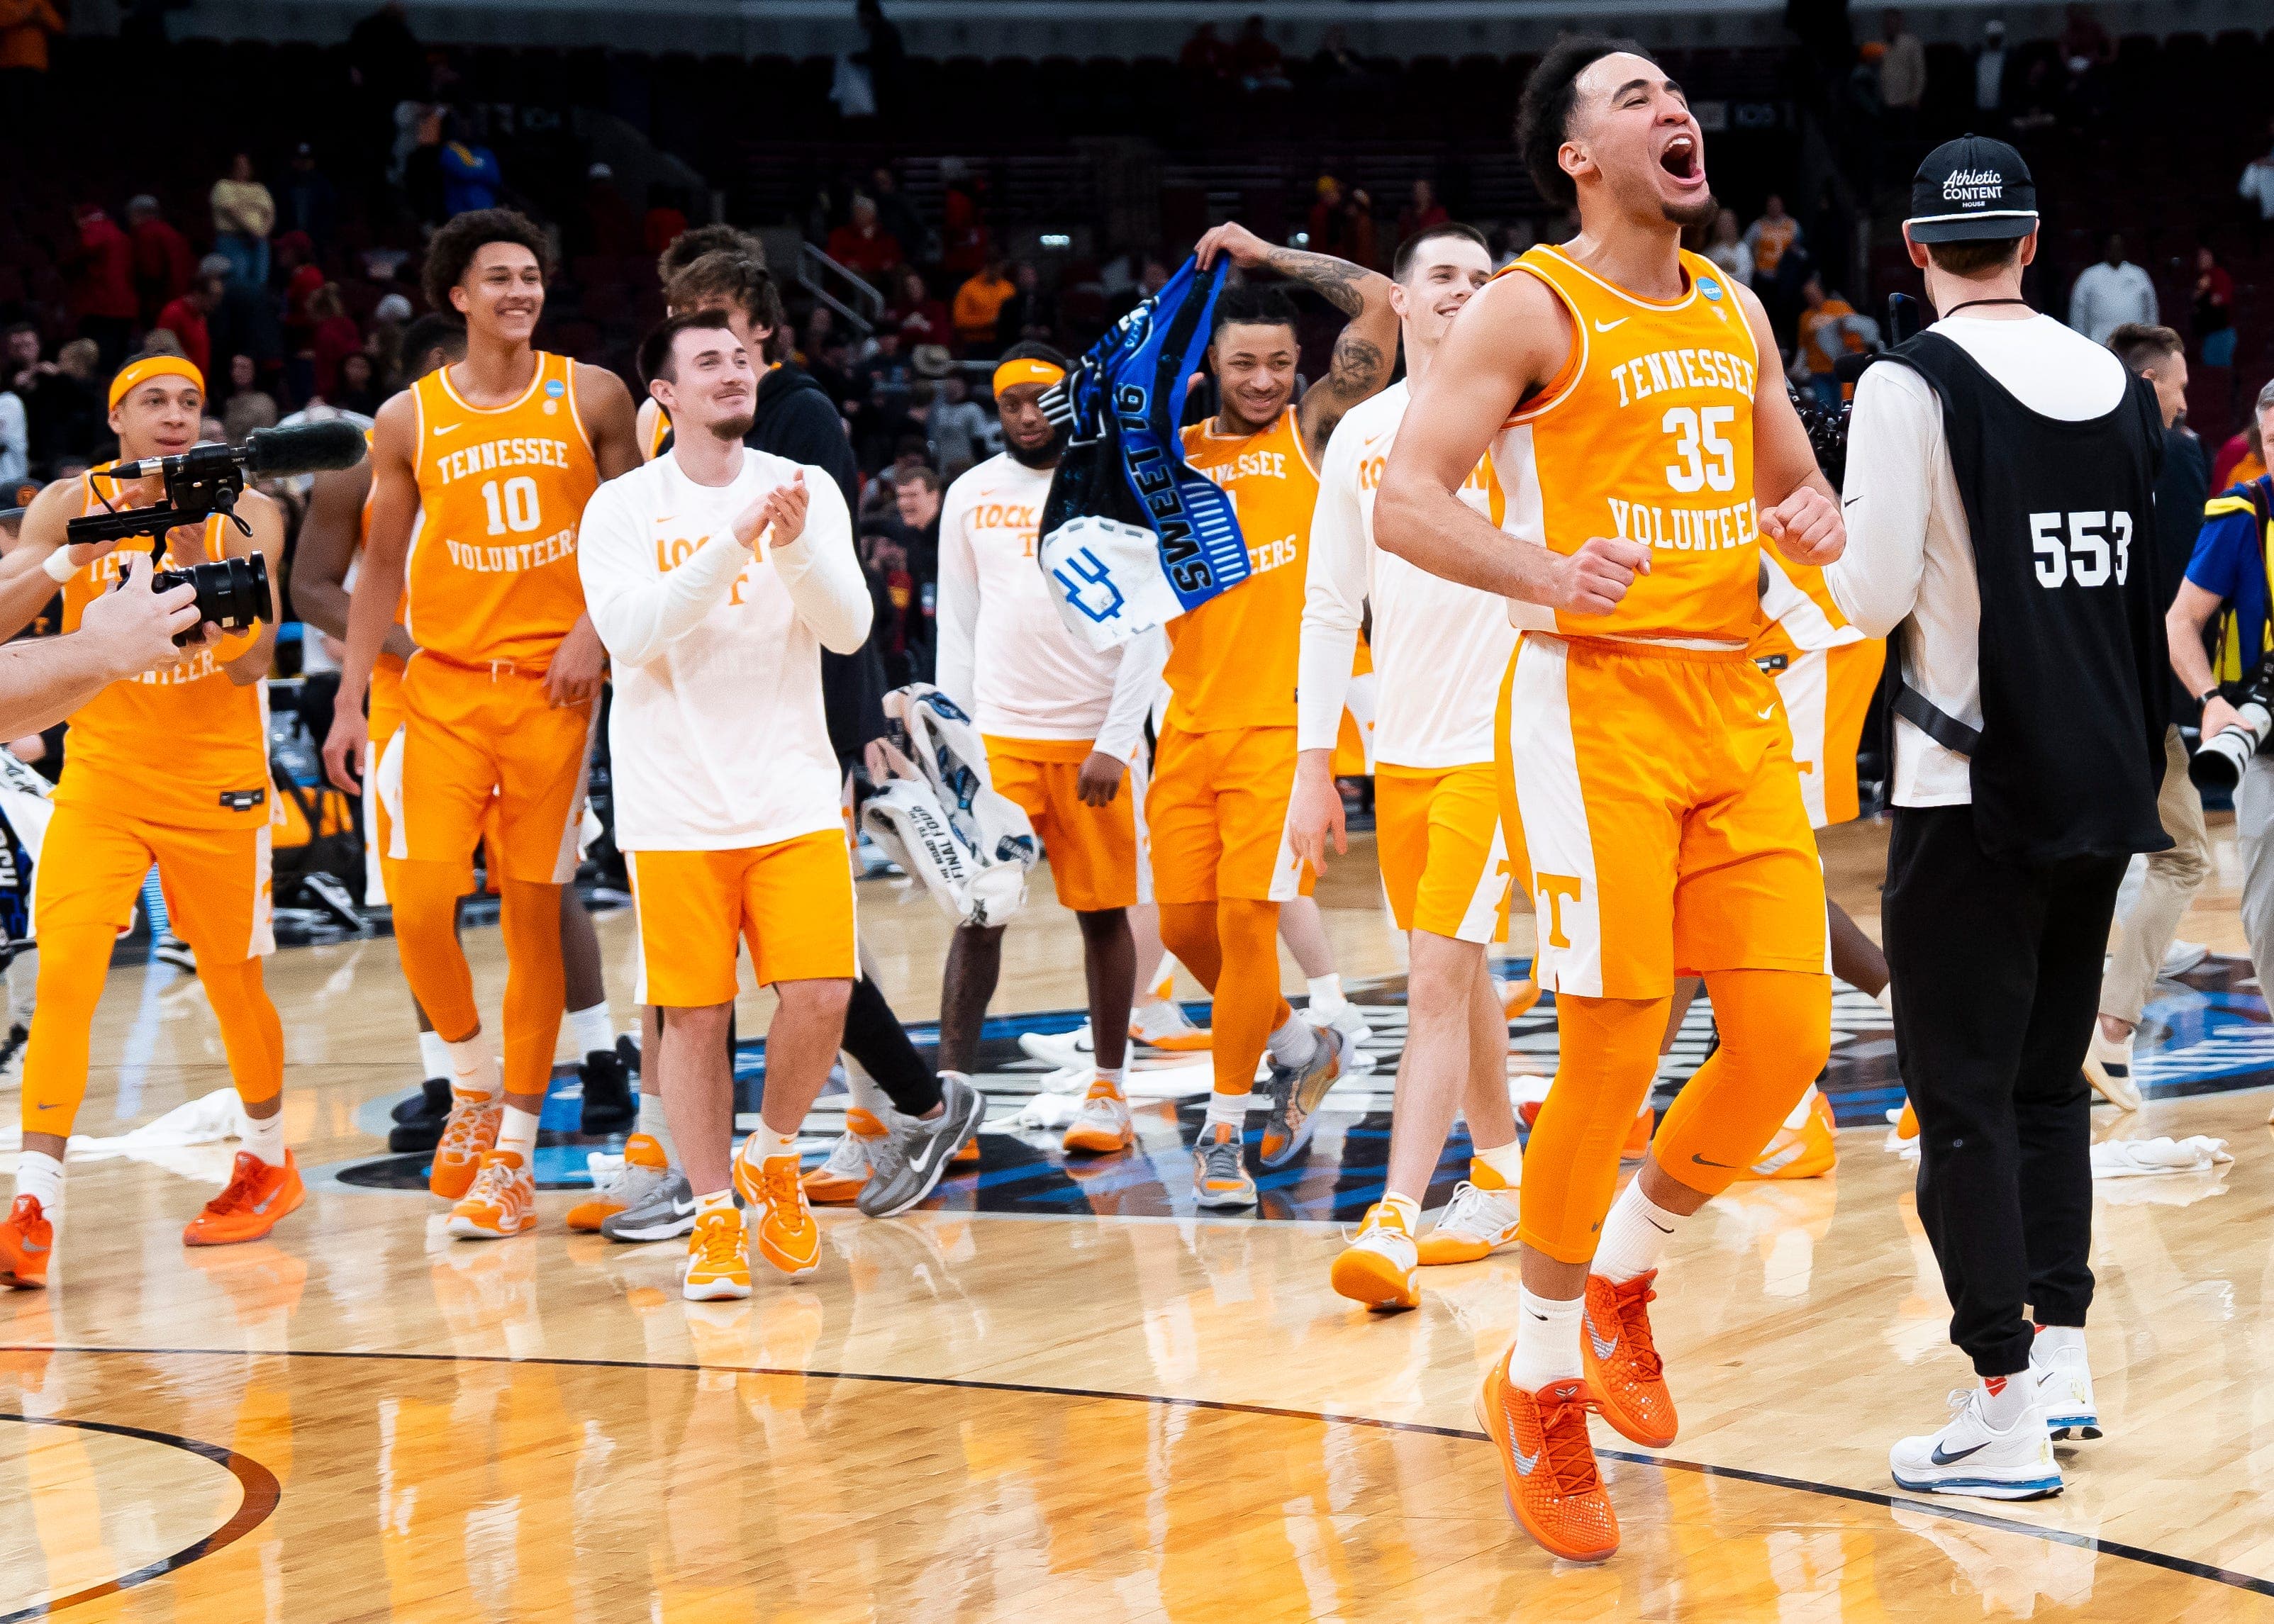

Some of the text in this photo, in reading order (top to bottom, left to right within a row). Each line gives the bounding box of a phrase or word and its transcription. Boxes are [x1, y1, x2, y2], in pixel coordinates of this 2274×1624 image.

[1943, 169, 2002, 189] Athletic
[1943, 186, 2002, 199] CONTENT
[1113, 381, 1149, 432] 16
[1610, 349, 1754, 408] TENNESSEE
[437, 437, 568, 484] TENNESSEE
[1662, 406, 1735, 493] 35
[481, 476, 541, 536] 10
[1125, 444, 1215, 594] SWEET
[2029, 510, 2133, 588] 553
[912, 805, 964, 878] FINAL FOUR
[1537, 872, 1582, 948] T
